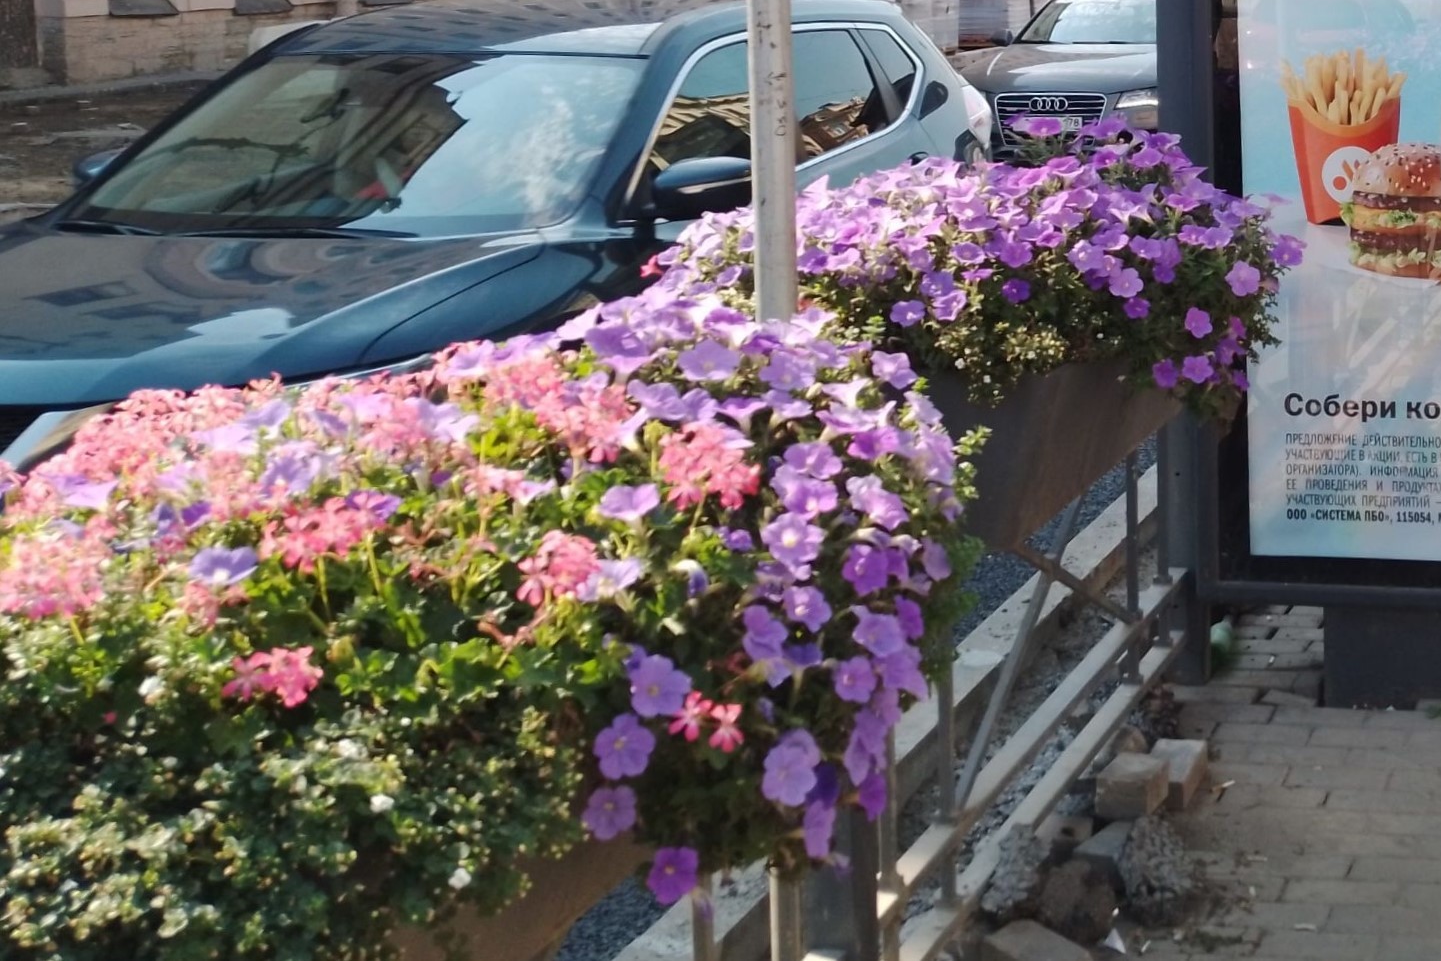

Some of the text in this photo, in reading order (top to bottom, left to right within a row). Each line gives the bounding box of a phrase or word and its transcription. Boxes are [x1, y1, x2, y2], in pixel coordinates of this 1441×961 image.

[1284, 392, 1397, 422] Собери
[1286, 434, 1357, 447] ПРЕДЛОЖЕНИЕ
[1362, 433, 1441, 448] ДЕЙСТВИТЕЛЬНО
[1359, 451, 1365, 461] В
[1430, 453, 1437, 464] В
[1286, 479, 1297, 490] ЕЕ
[1305, 479, 1368, 491] ПРОВЕДЕНИЯ
[1376, 480, 1384, 491] И
[1286, 493, 1357, 506] УЧАСТВУЮЩИХ
[1361, 494, 1431, 509] ПРЕДПРИЯТИЙ
[1286, 508, 1307, 521] ООО
[1310, 509, 1361, 522] «СИСТЕМА
[1397, 511, 1435, 525] 115054,
